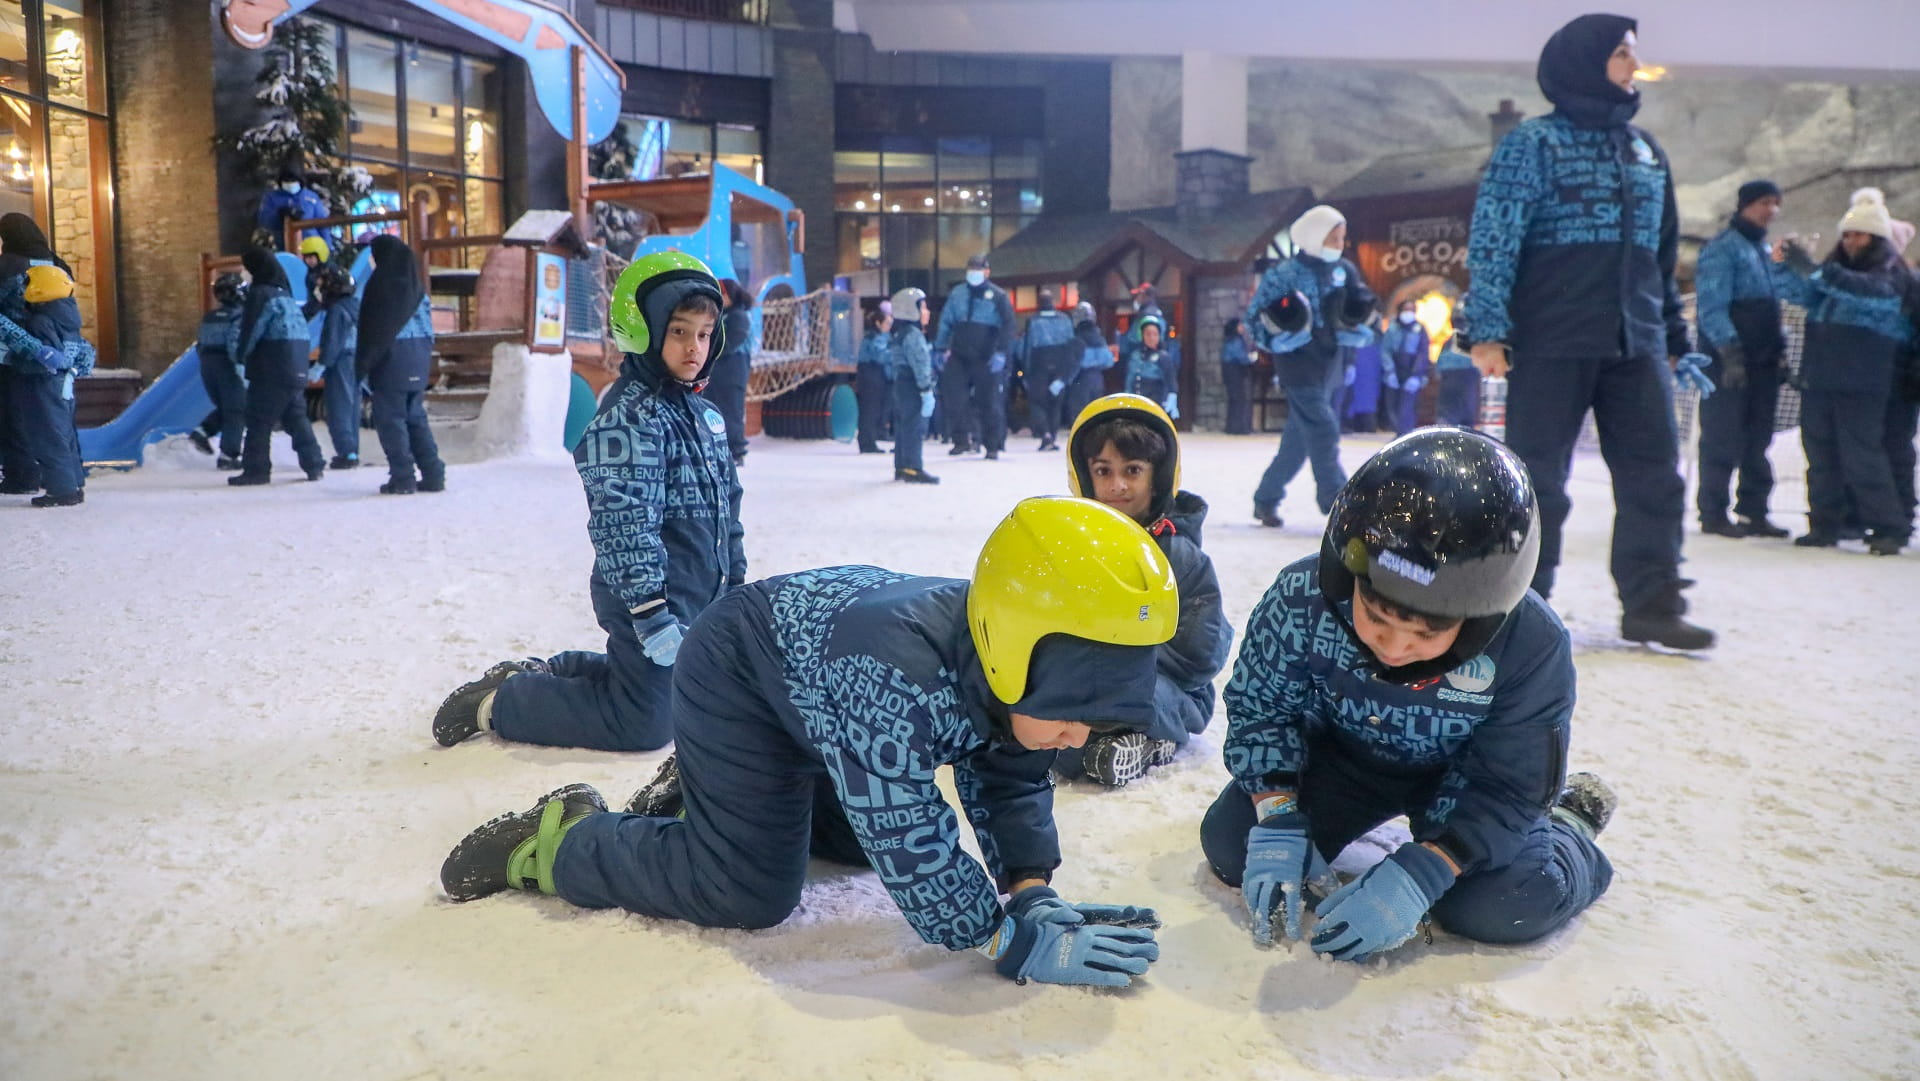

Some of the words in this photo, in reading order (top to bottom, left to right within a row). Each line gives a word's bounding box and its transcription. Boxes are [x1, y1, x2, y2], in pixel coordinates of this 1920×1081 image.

[1380, 240, 1468, 273] COCOA
[621, 467, 632, 479] &
[601, 507, 646, 527] RIDE
[610, 526, 620, 537] &
[616, 550, 658, 569] RIDE
[854, 672, 916, 719] ENJOY
[872, 805, 928, 831] RIDE
[912, 855, 972, 908] RIDE
[936, 902, 958, 920] &
